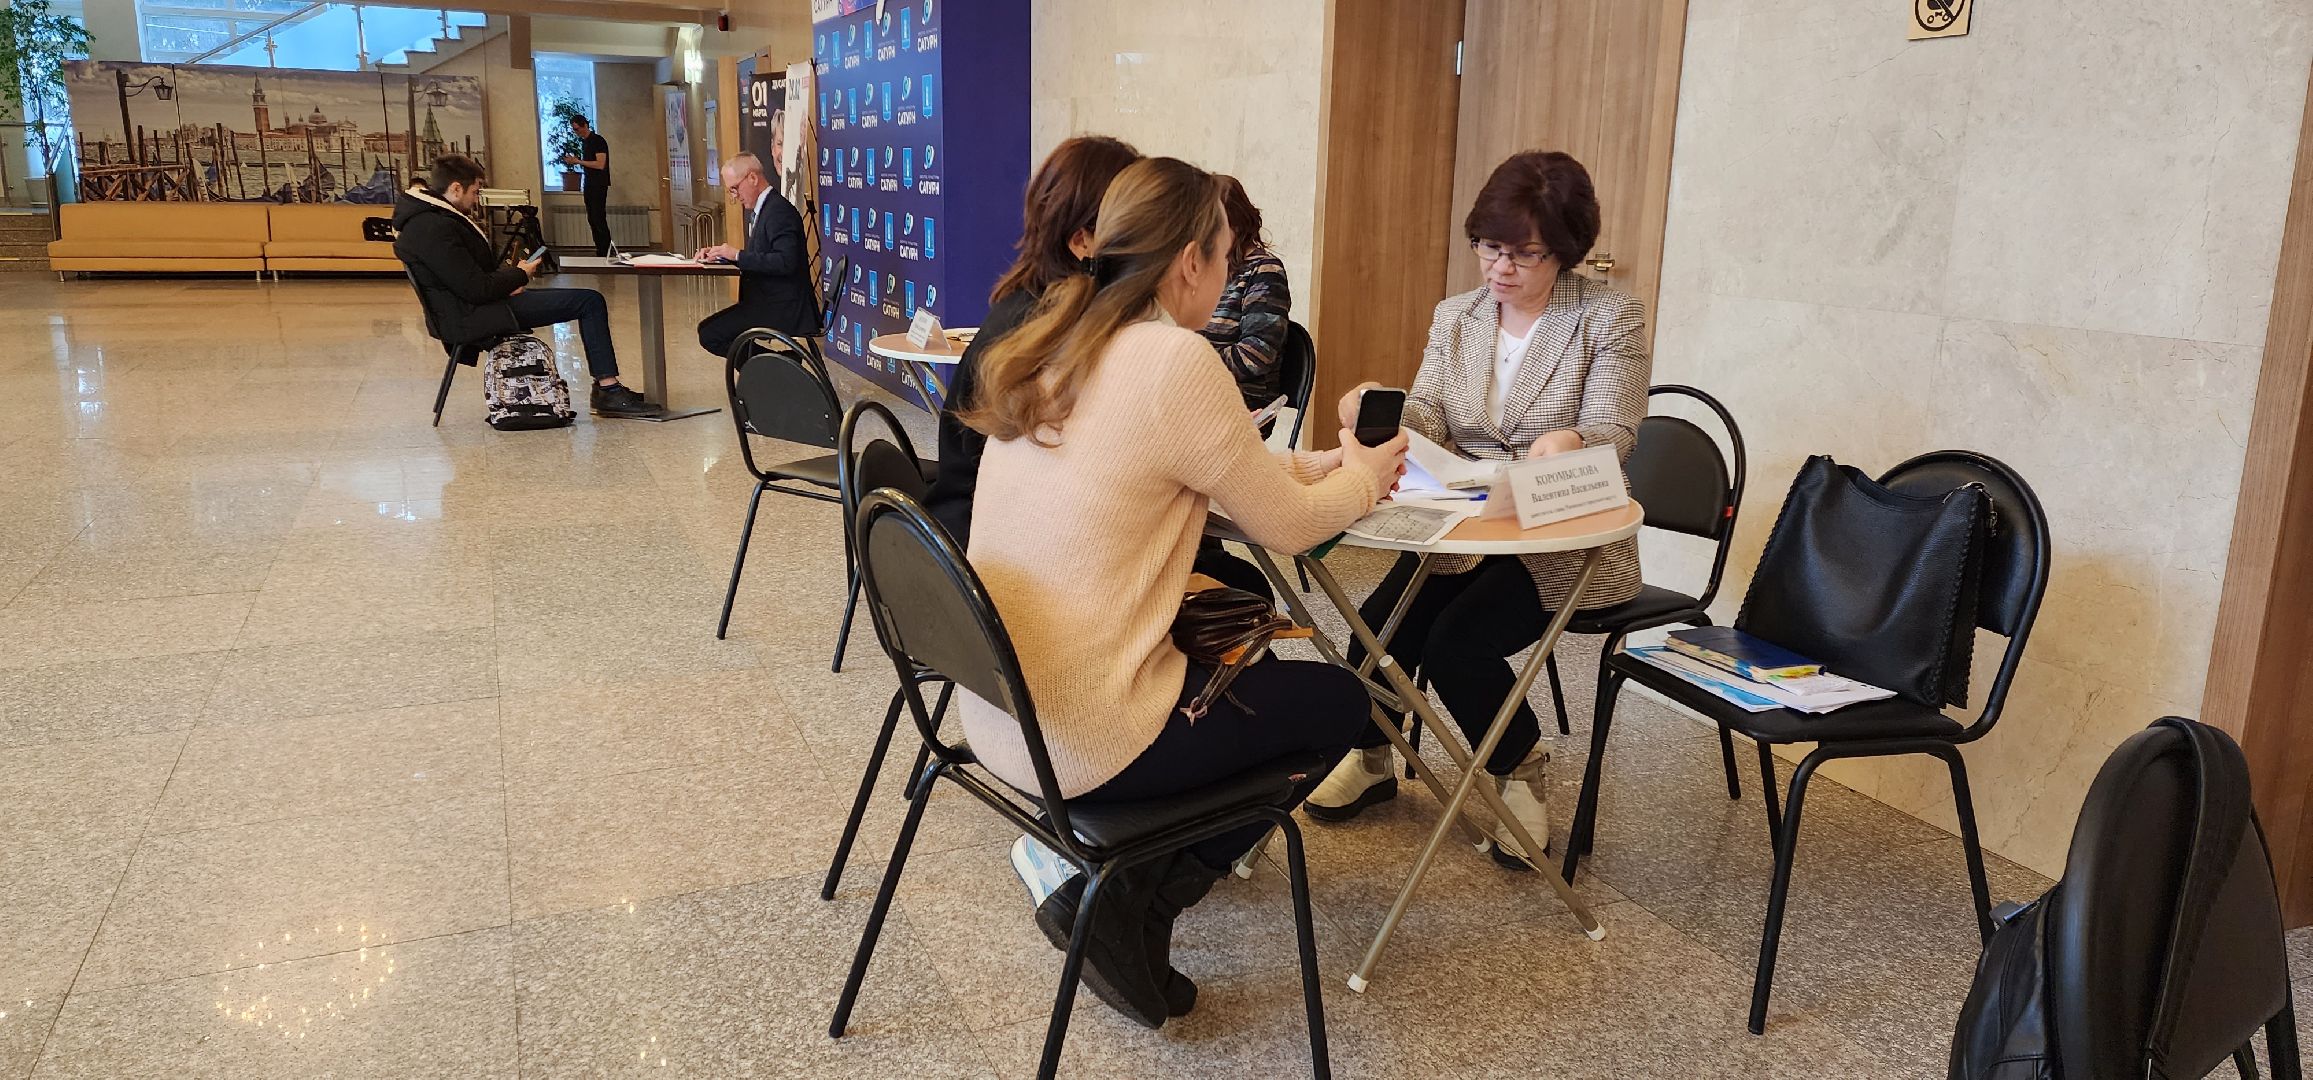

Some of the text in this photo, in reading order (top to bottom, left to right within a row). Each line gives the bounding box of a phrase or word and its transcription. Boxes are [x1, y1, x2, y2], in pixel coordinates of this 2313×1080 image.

[918, 34, 937, 53] САТУРН
[752, 81, 768, 107] 01
[881, 179, 898, 191] САТУРН
[919, 180, 939, 195] САТУРН
[900, 245, 918, 260] САТУРН
[883, 303, 900, 319] САТУРН
[1535, 464, 1600, 486] КОРОМЫСЛОВА
[1531, 480, 1610, 504] Валентина Васильевна
